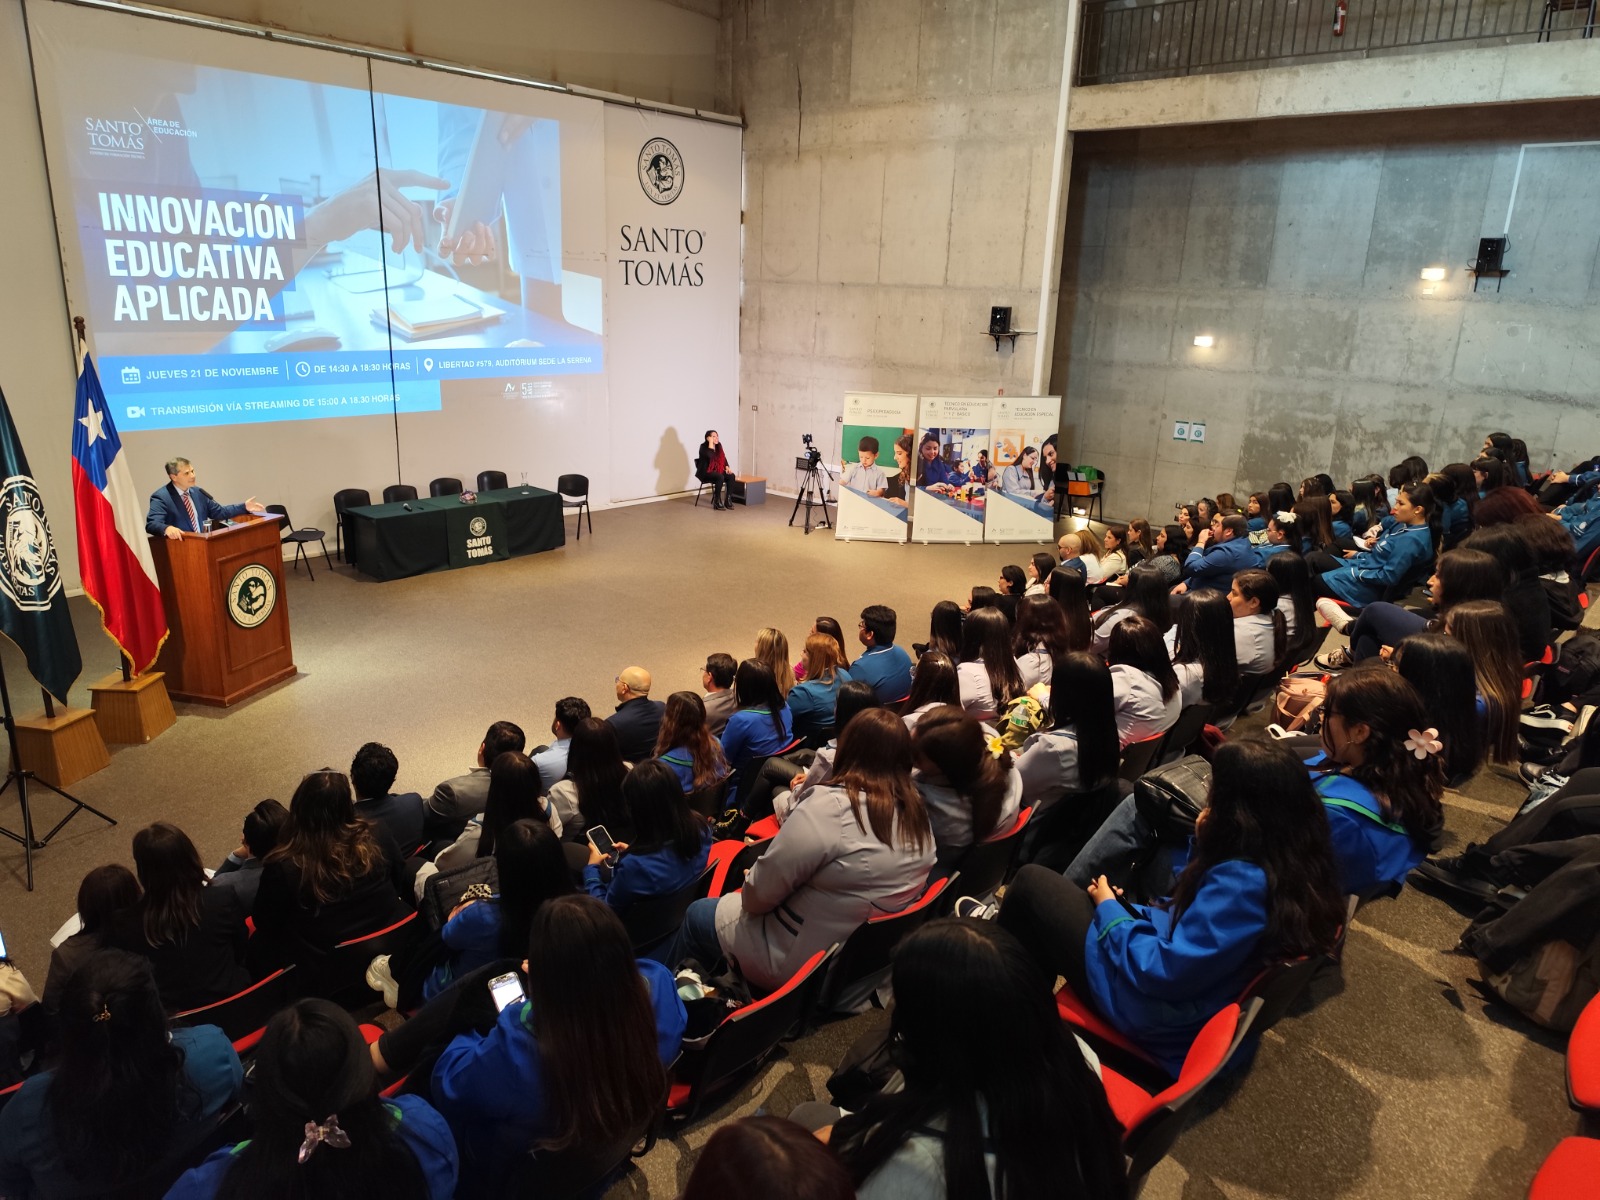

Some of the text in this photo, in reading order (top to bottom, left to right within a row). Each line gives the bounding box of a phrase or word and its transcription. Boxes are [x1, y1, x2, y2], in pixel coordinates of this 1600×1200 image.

[85, 117, 142, 136] SANTO
[147, 116, 181, 128] ÁREA DE
[87, 132, 145, 150] TOMÁS
[153, 126, 198, 138] EDUCACIÓN
[98, 192, 296, 241] INNOVACIÓN
[620, 224, 704, 254] SANTO
[104, 238, 285, 281] EDUCATIVA
[618, 256, 704, 287] TOMÁS
[113, 284, 275, 321] APLICADA
[314, 365, 327, 374] DE
[328, 364, 350, 373] 14:30
[351, 363, 359, 372] A
[360, 363, 381, 372] 18:30
[438, 360, 475, 369] LIBERTAD
[538, 357, 556, 366] SEDE
[557, 357, 566, 365] LA
[566, 356, 592, 364] SERENA
[146, 366, 280, 380] JUEVES 21 DE NOVIEMBRE
[150, 402, 224, 416] TRANSMISIÓN
[226, 400, 243, 411] VÍA
[244, 399, 300, 411] STREAMING
[302, 398, 315, 407] DE
[317, 397, 339, 406] 15:00
[340, 397, 348, 405] A
[371, 393, 401, 404] HORAS
[466, 535, 492, 549] SANTO
[466, 545, 494, 559] TOMÁS
